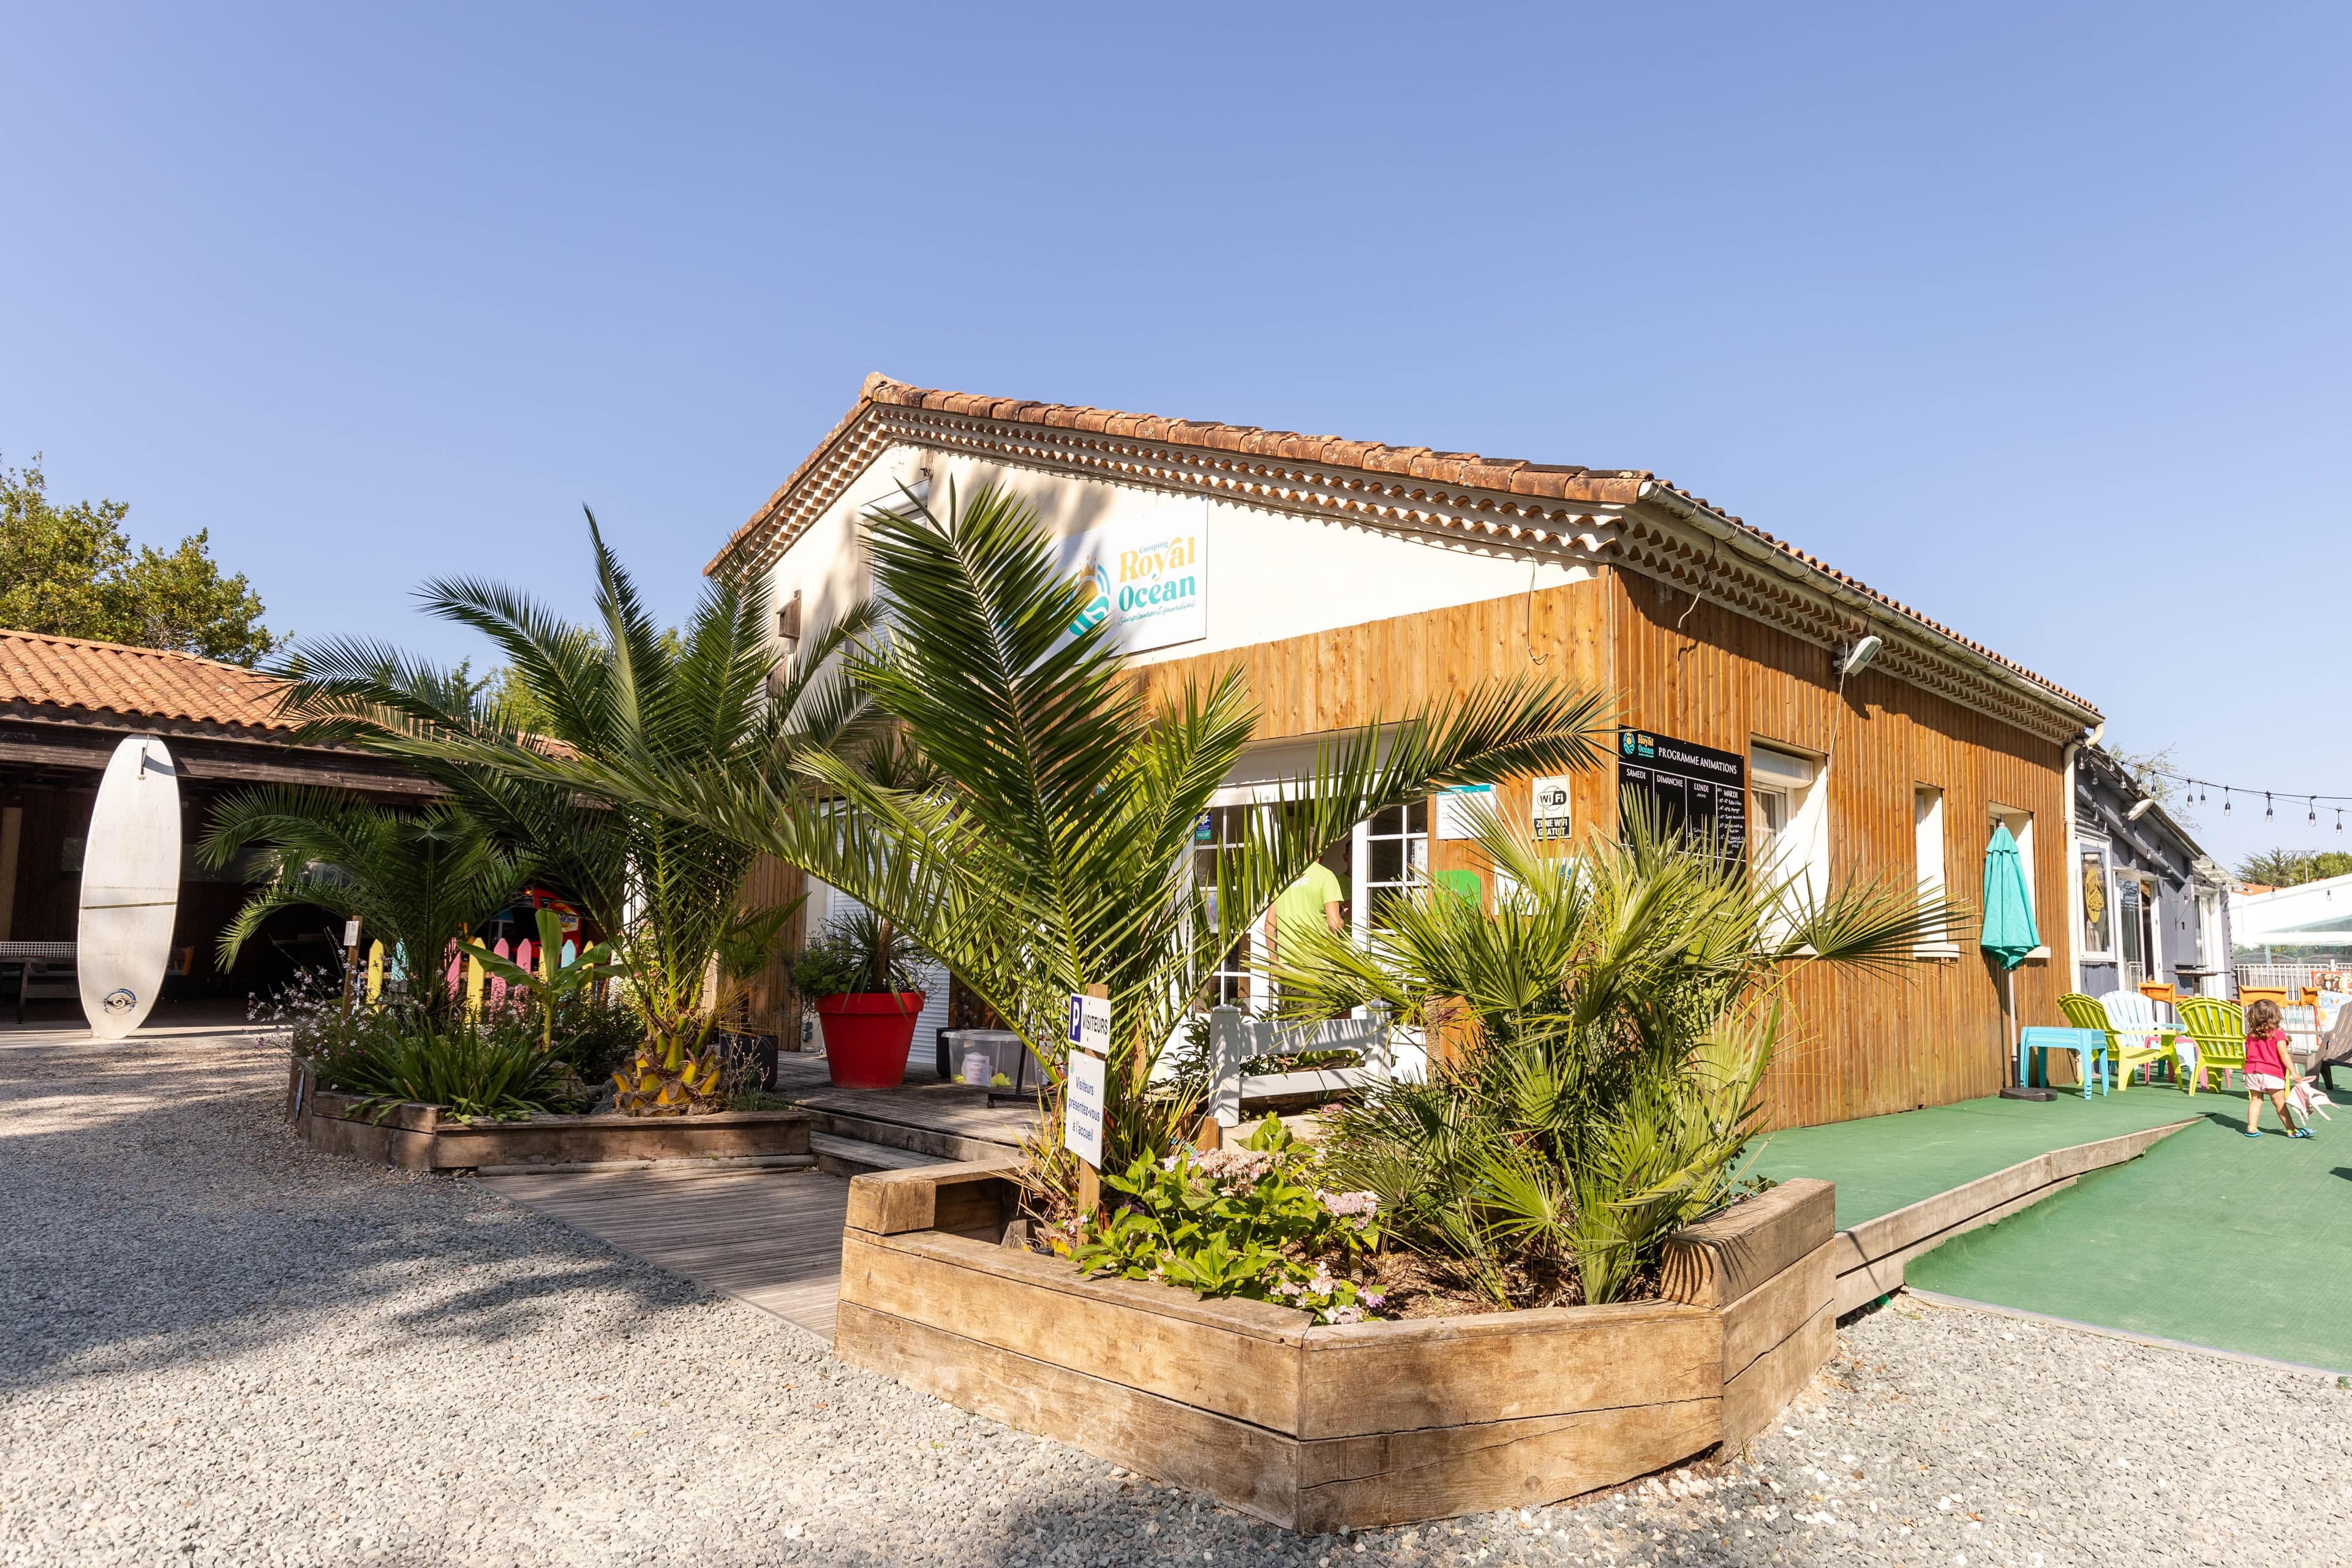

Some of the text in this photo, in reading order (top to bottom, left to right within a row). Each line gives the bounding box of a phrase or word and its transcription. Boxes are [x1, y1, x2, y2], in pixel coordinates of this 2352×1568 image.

[1139, 540, 1169, 554] Camping
[1120, 537, 1195, 582] Royal
[1118, 599, 1196, 626] Simplement familial
[1637, 734, 1654, 747] Royal
[1658, 747, 1738, 775] PROGRAMME ANIMATIONS
[1626, 768, 1646, 780] SAMEDI
[1656, 774, 1684, 788] DIMANCHE
[1694, 783, 1709, 793] LUNDI
[1724, 790, 1738, 799] MARDI
[1538, 827, 1566, 836] GATUT
[1072, 1001, 1109, 1036] P VISITEURS
[1076, 1076, 1095, 1096] Visiteurs
[1068, 1096, 1100, 1123] présentez-vous
[1072, 1118, 1094, 1142] à l'accueil
